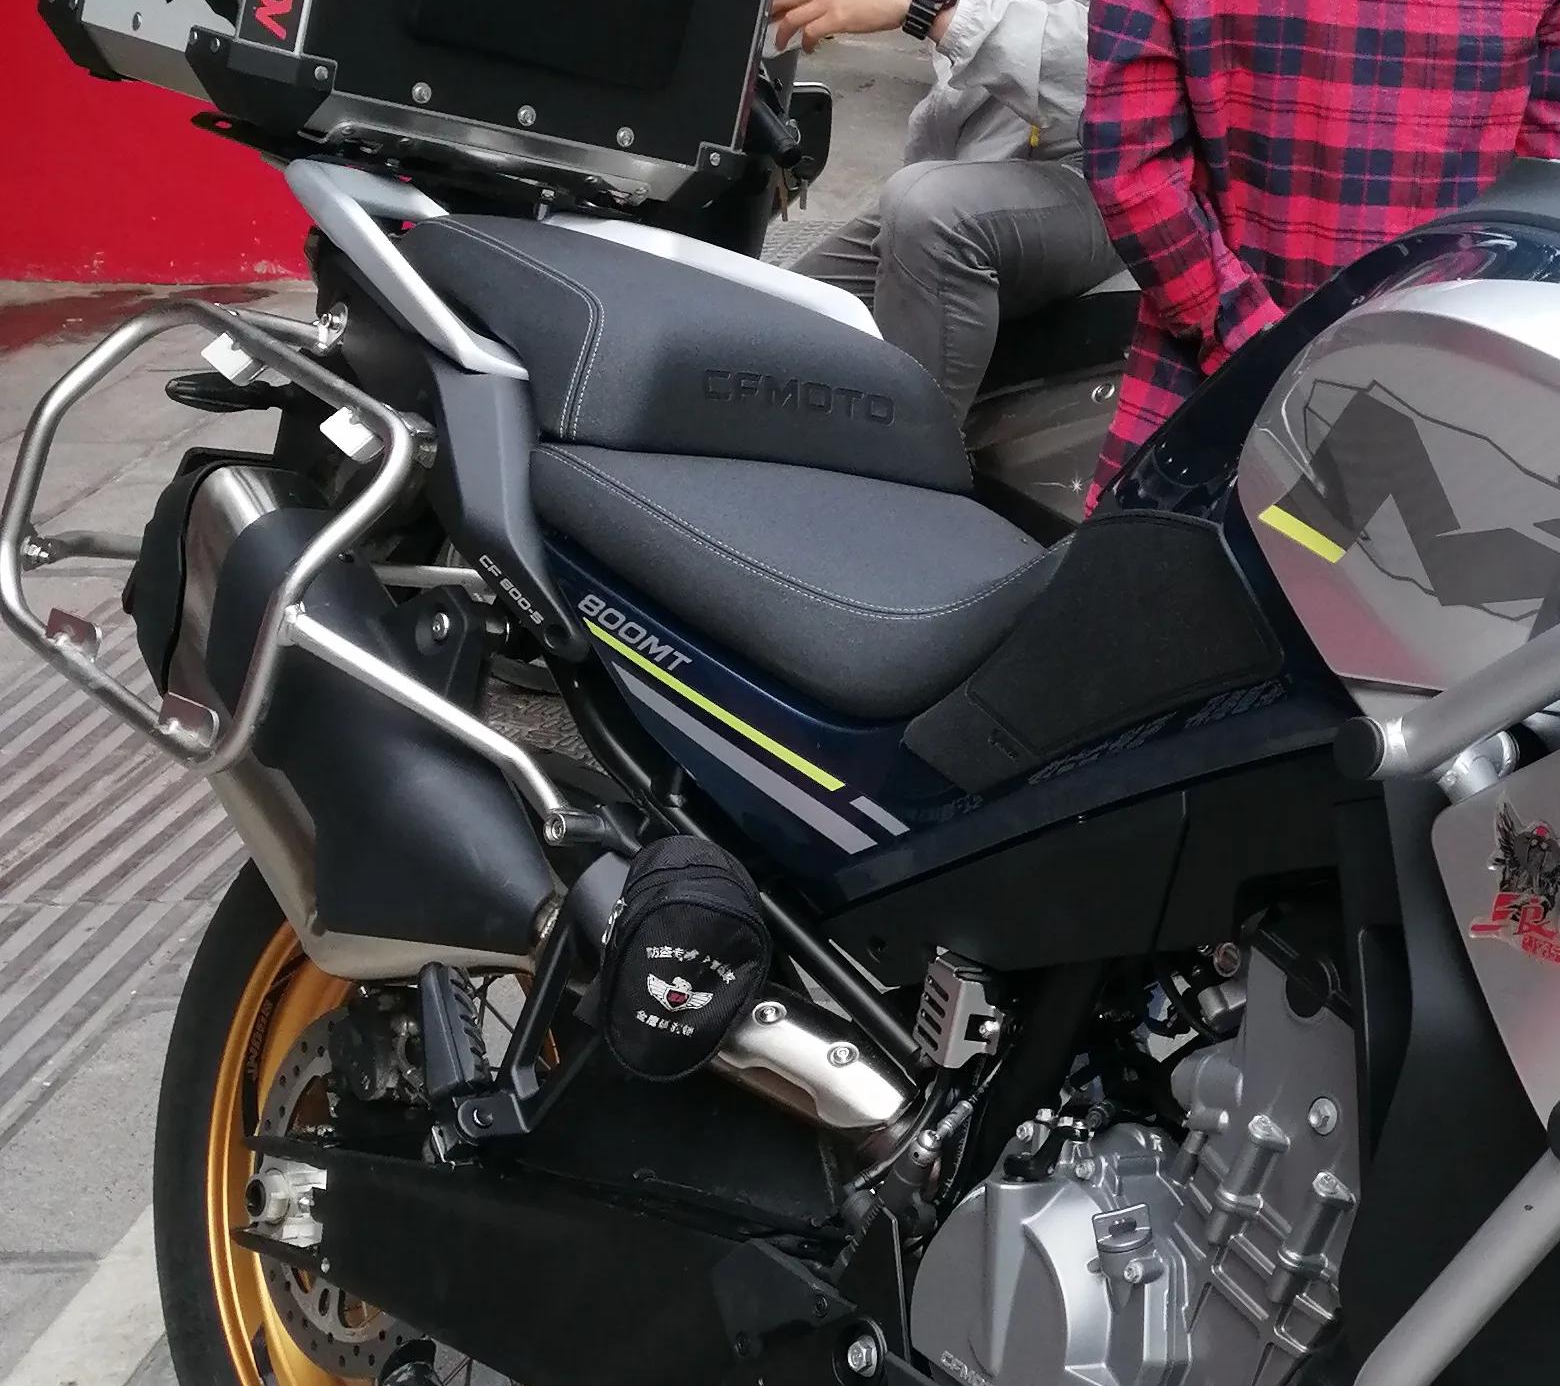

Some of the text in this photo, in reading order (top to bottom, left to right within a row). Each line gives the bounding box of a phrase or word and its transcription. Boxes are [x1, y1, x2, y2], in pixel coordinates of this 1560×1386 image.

[704, 368, 895, 427] CFMOTO
[479, 554, 502, 577] CF
[577, 594, 693, 671] 800MT
